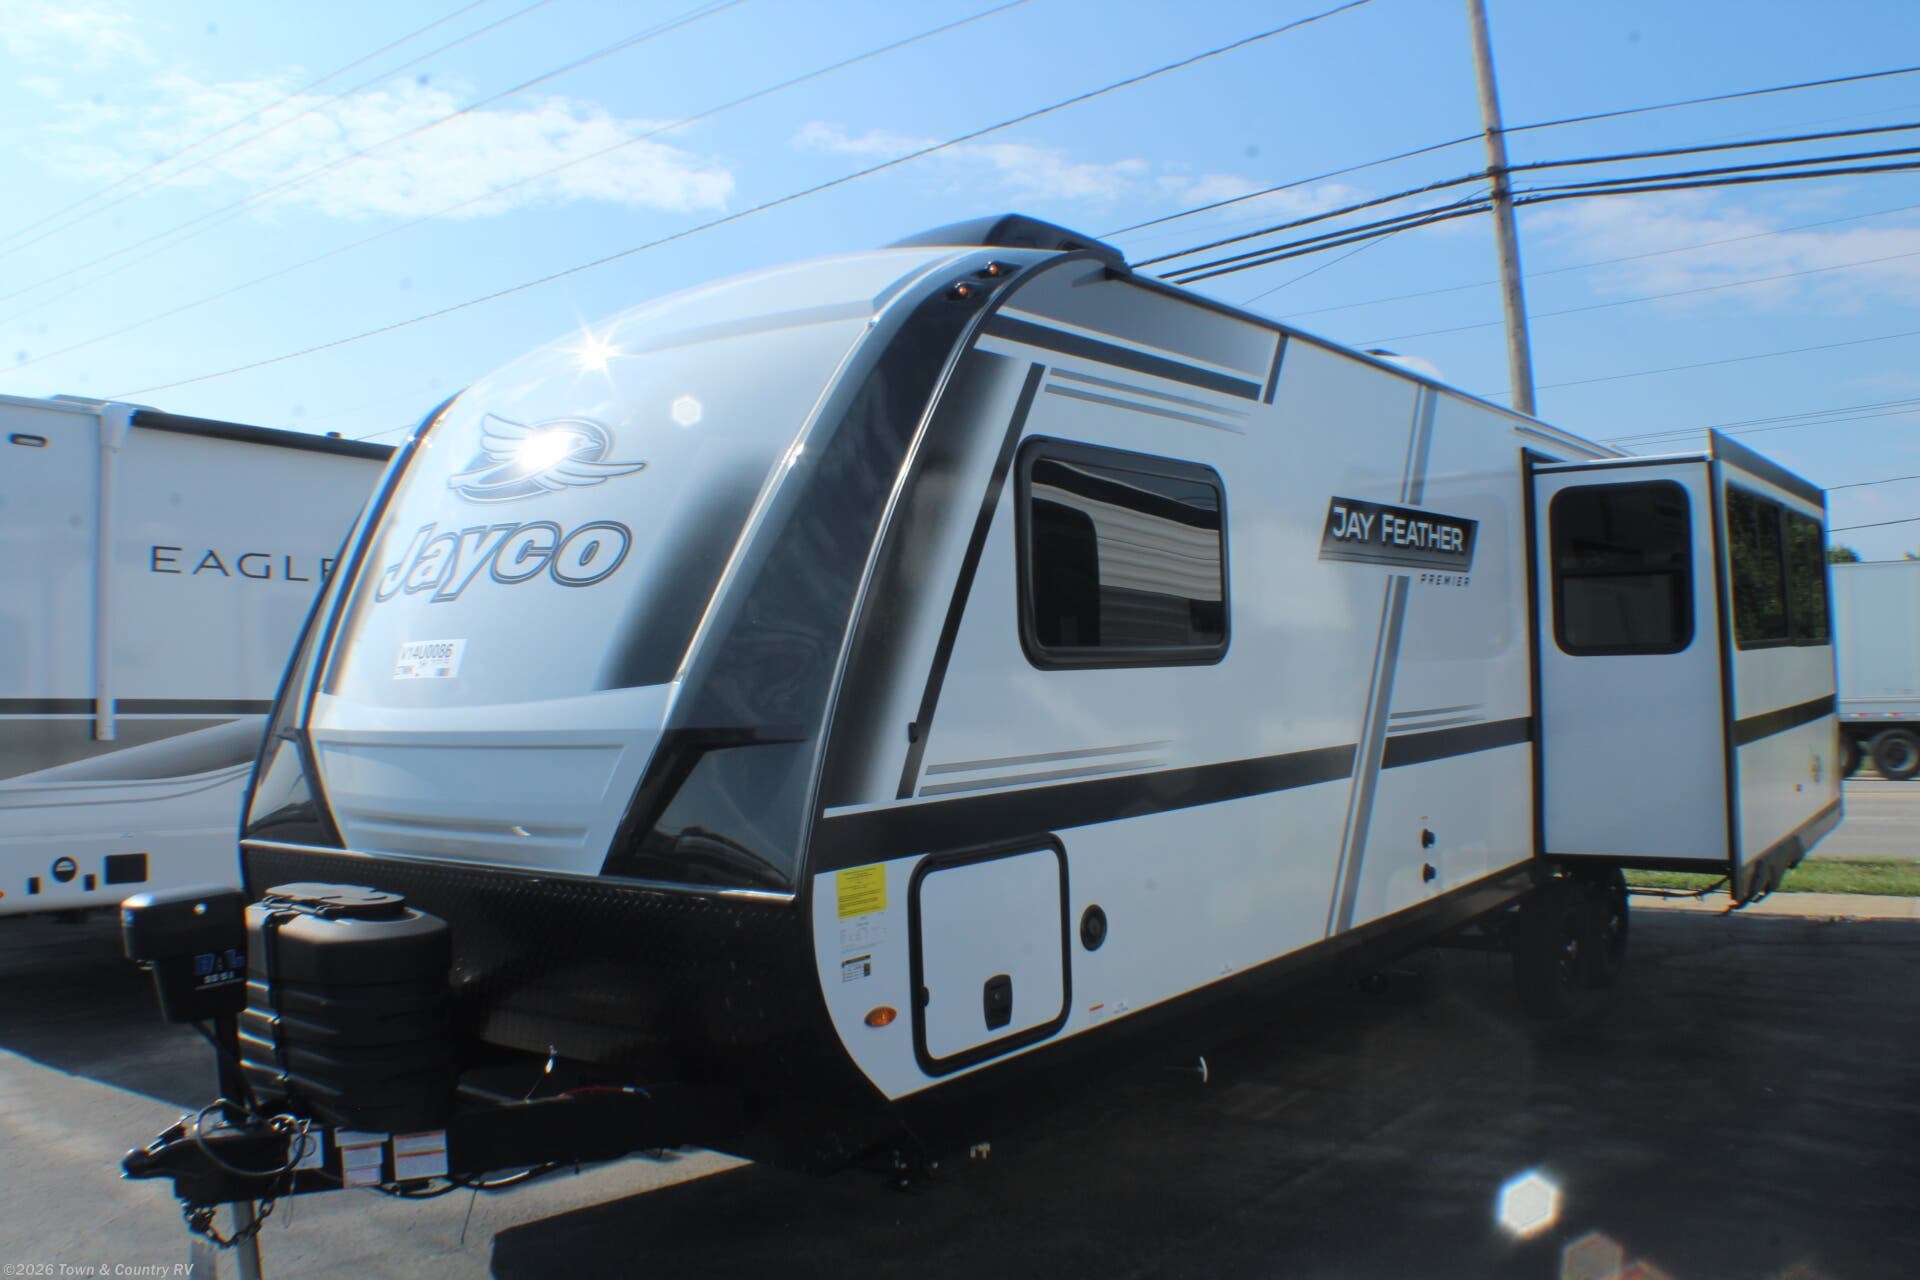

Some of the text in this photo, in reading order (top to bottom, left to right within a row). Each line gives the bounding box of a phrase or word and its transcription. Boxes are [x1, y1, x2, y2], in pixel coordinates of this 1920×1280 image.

[1333, 506, 1463, 551] JAY FEATHER
[375, 520, 632, 603] Jayco
[1420, 573, 1470, 588] PREMIER
